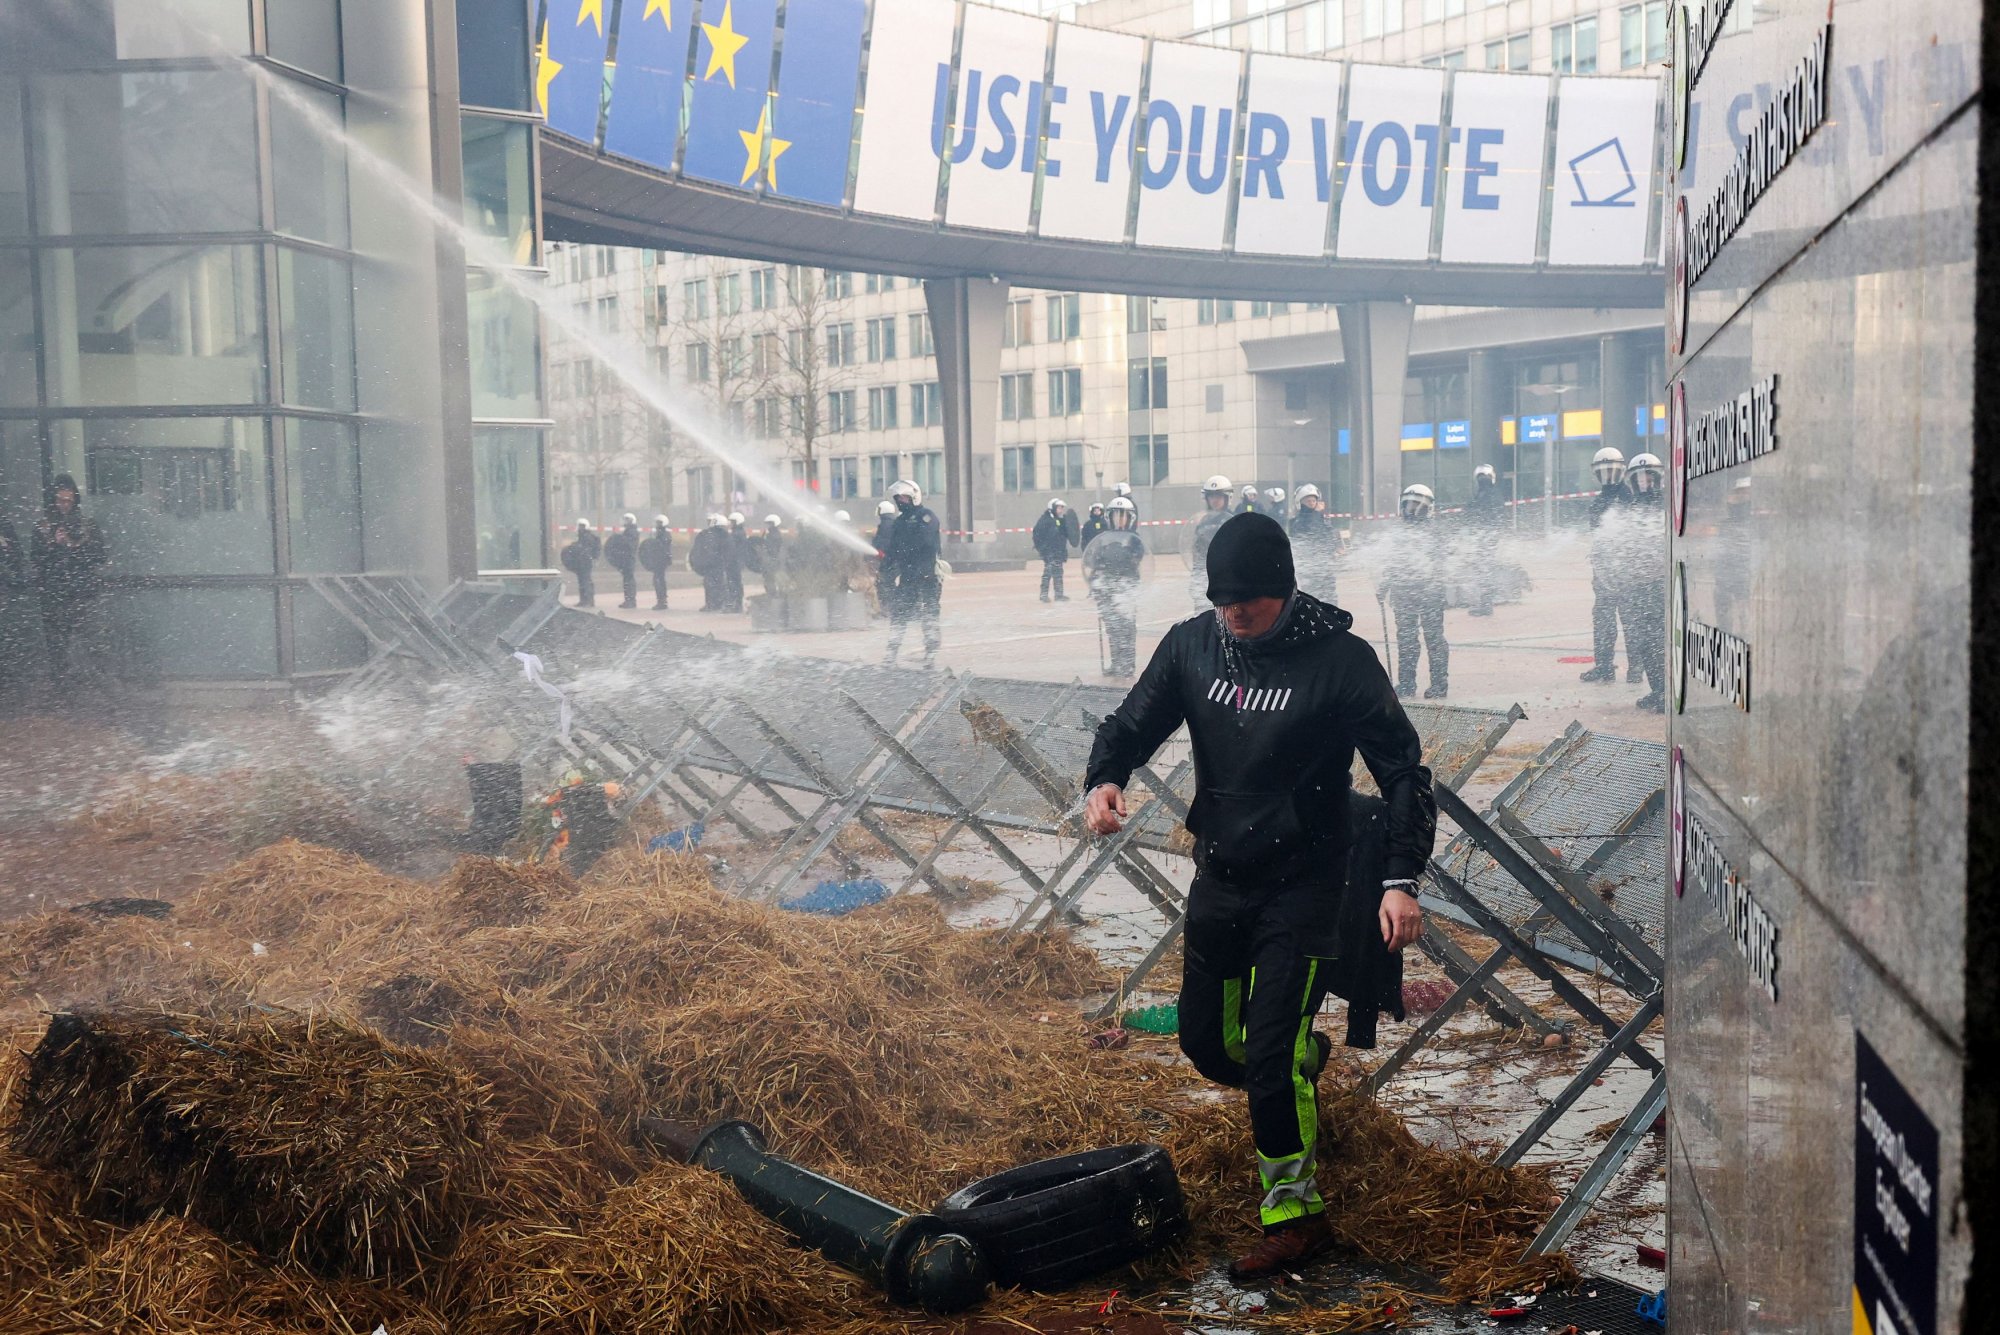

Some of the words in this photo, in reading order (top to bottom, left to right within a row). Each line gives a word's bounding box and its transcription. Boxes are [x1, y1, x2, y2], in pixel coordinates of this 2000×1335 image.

[930, 62, 1067, 178] USE
[1089, 90, 1290, 200] YOUR
[1310, 117, 1505, 211] VOTE
[1687, 208, 1709, 288] HOUSE
[1709, 193, 1720, 260] OF
[1767, 24, 1828, 182] HISTORY
[1686, 416, 1706, 480] ZWEIG
[1706, 400, 1735, 473] VISITOR
[1736, 376, 1776, 463] CENTRE
[1714, 630, 1748, 711] GARDEN
[1686, 810, 1737, 941] ACCREDITATION
[1737, 881, 1776, 1003] CENTRE
